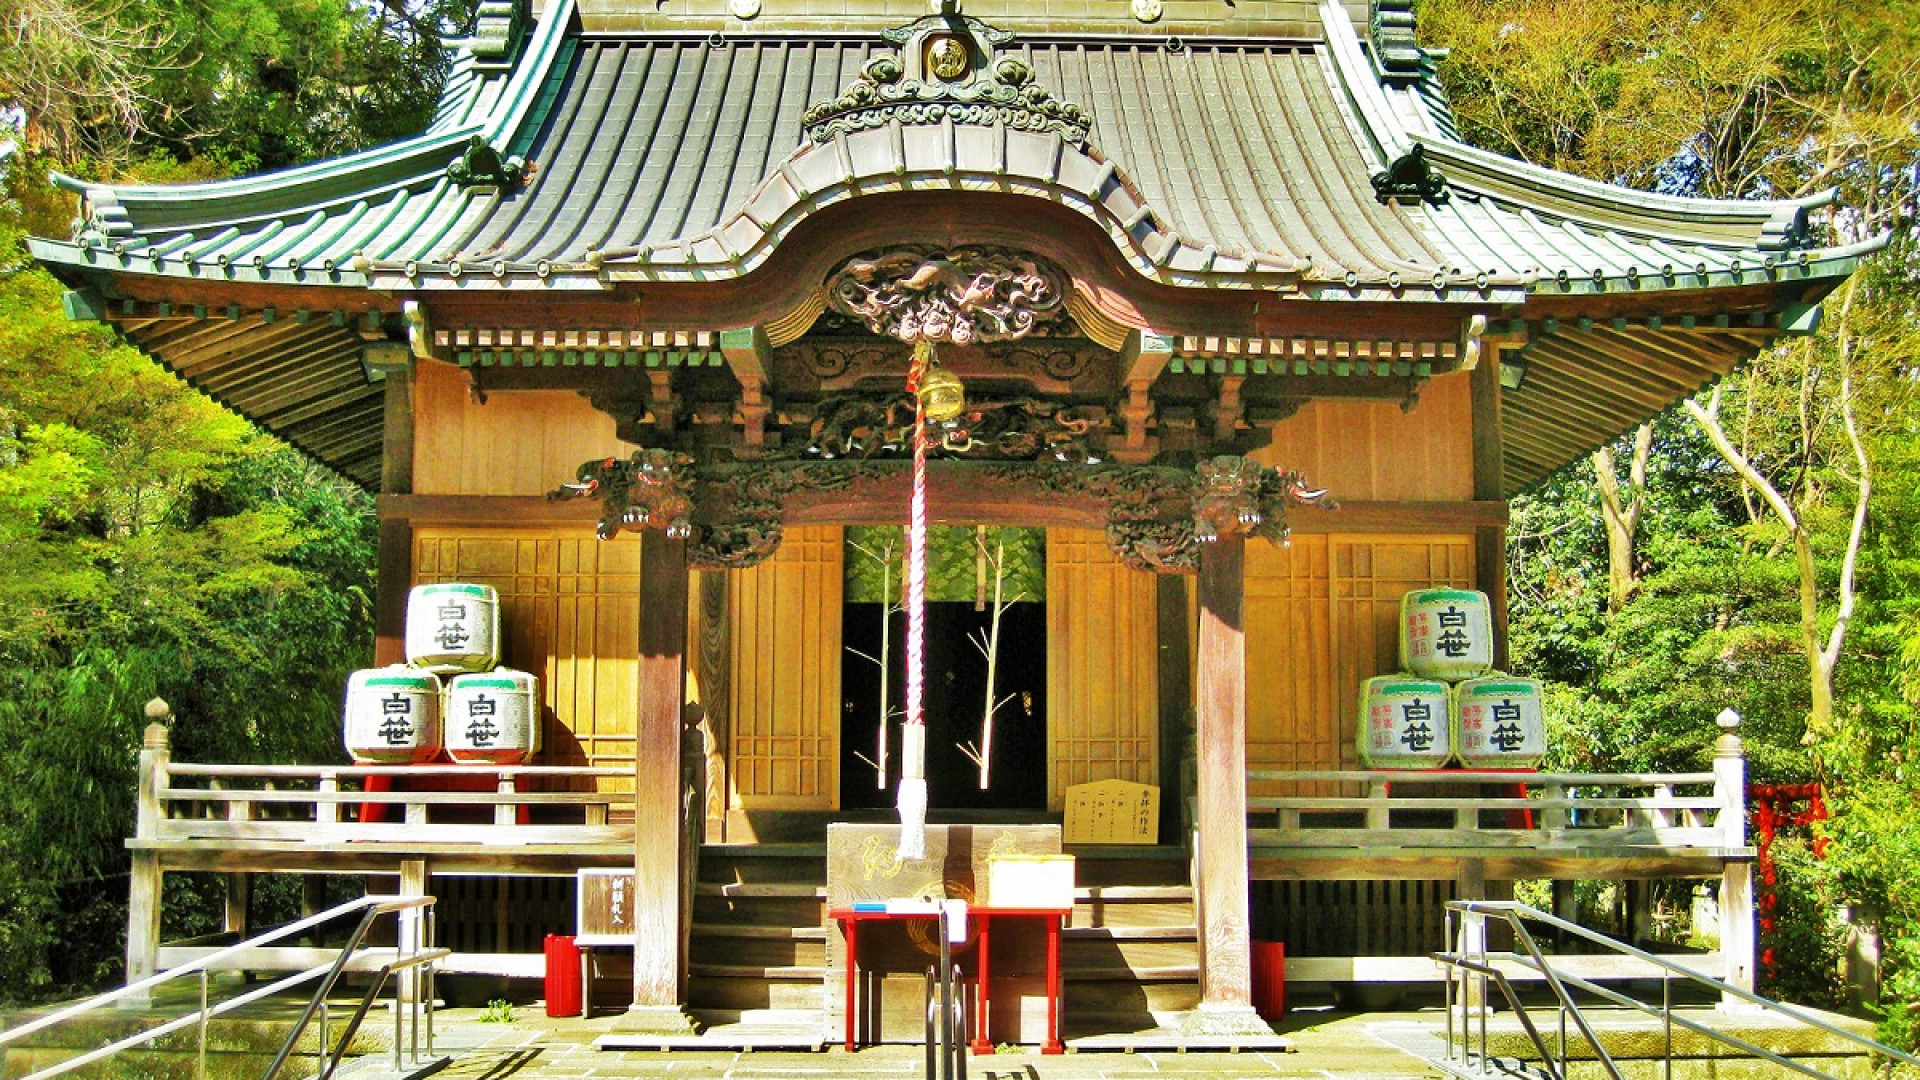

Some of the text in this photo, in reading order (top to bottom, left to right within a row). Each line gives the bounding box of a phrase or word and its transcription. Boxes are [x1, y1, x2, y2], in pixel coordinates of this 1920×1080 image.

[435, 598, 469, 650] 白笹
[1436, 605, 1471, 657] 白笹
[378, 692, 415, 746] 白笹
[465, 693, 500, 747] 白笹
[1401, 698, 1435, 752] 白笹
[1489, 699, 1525, 752] 白笹
